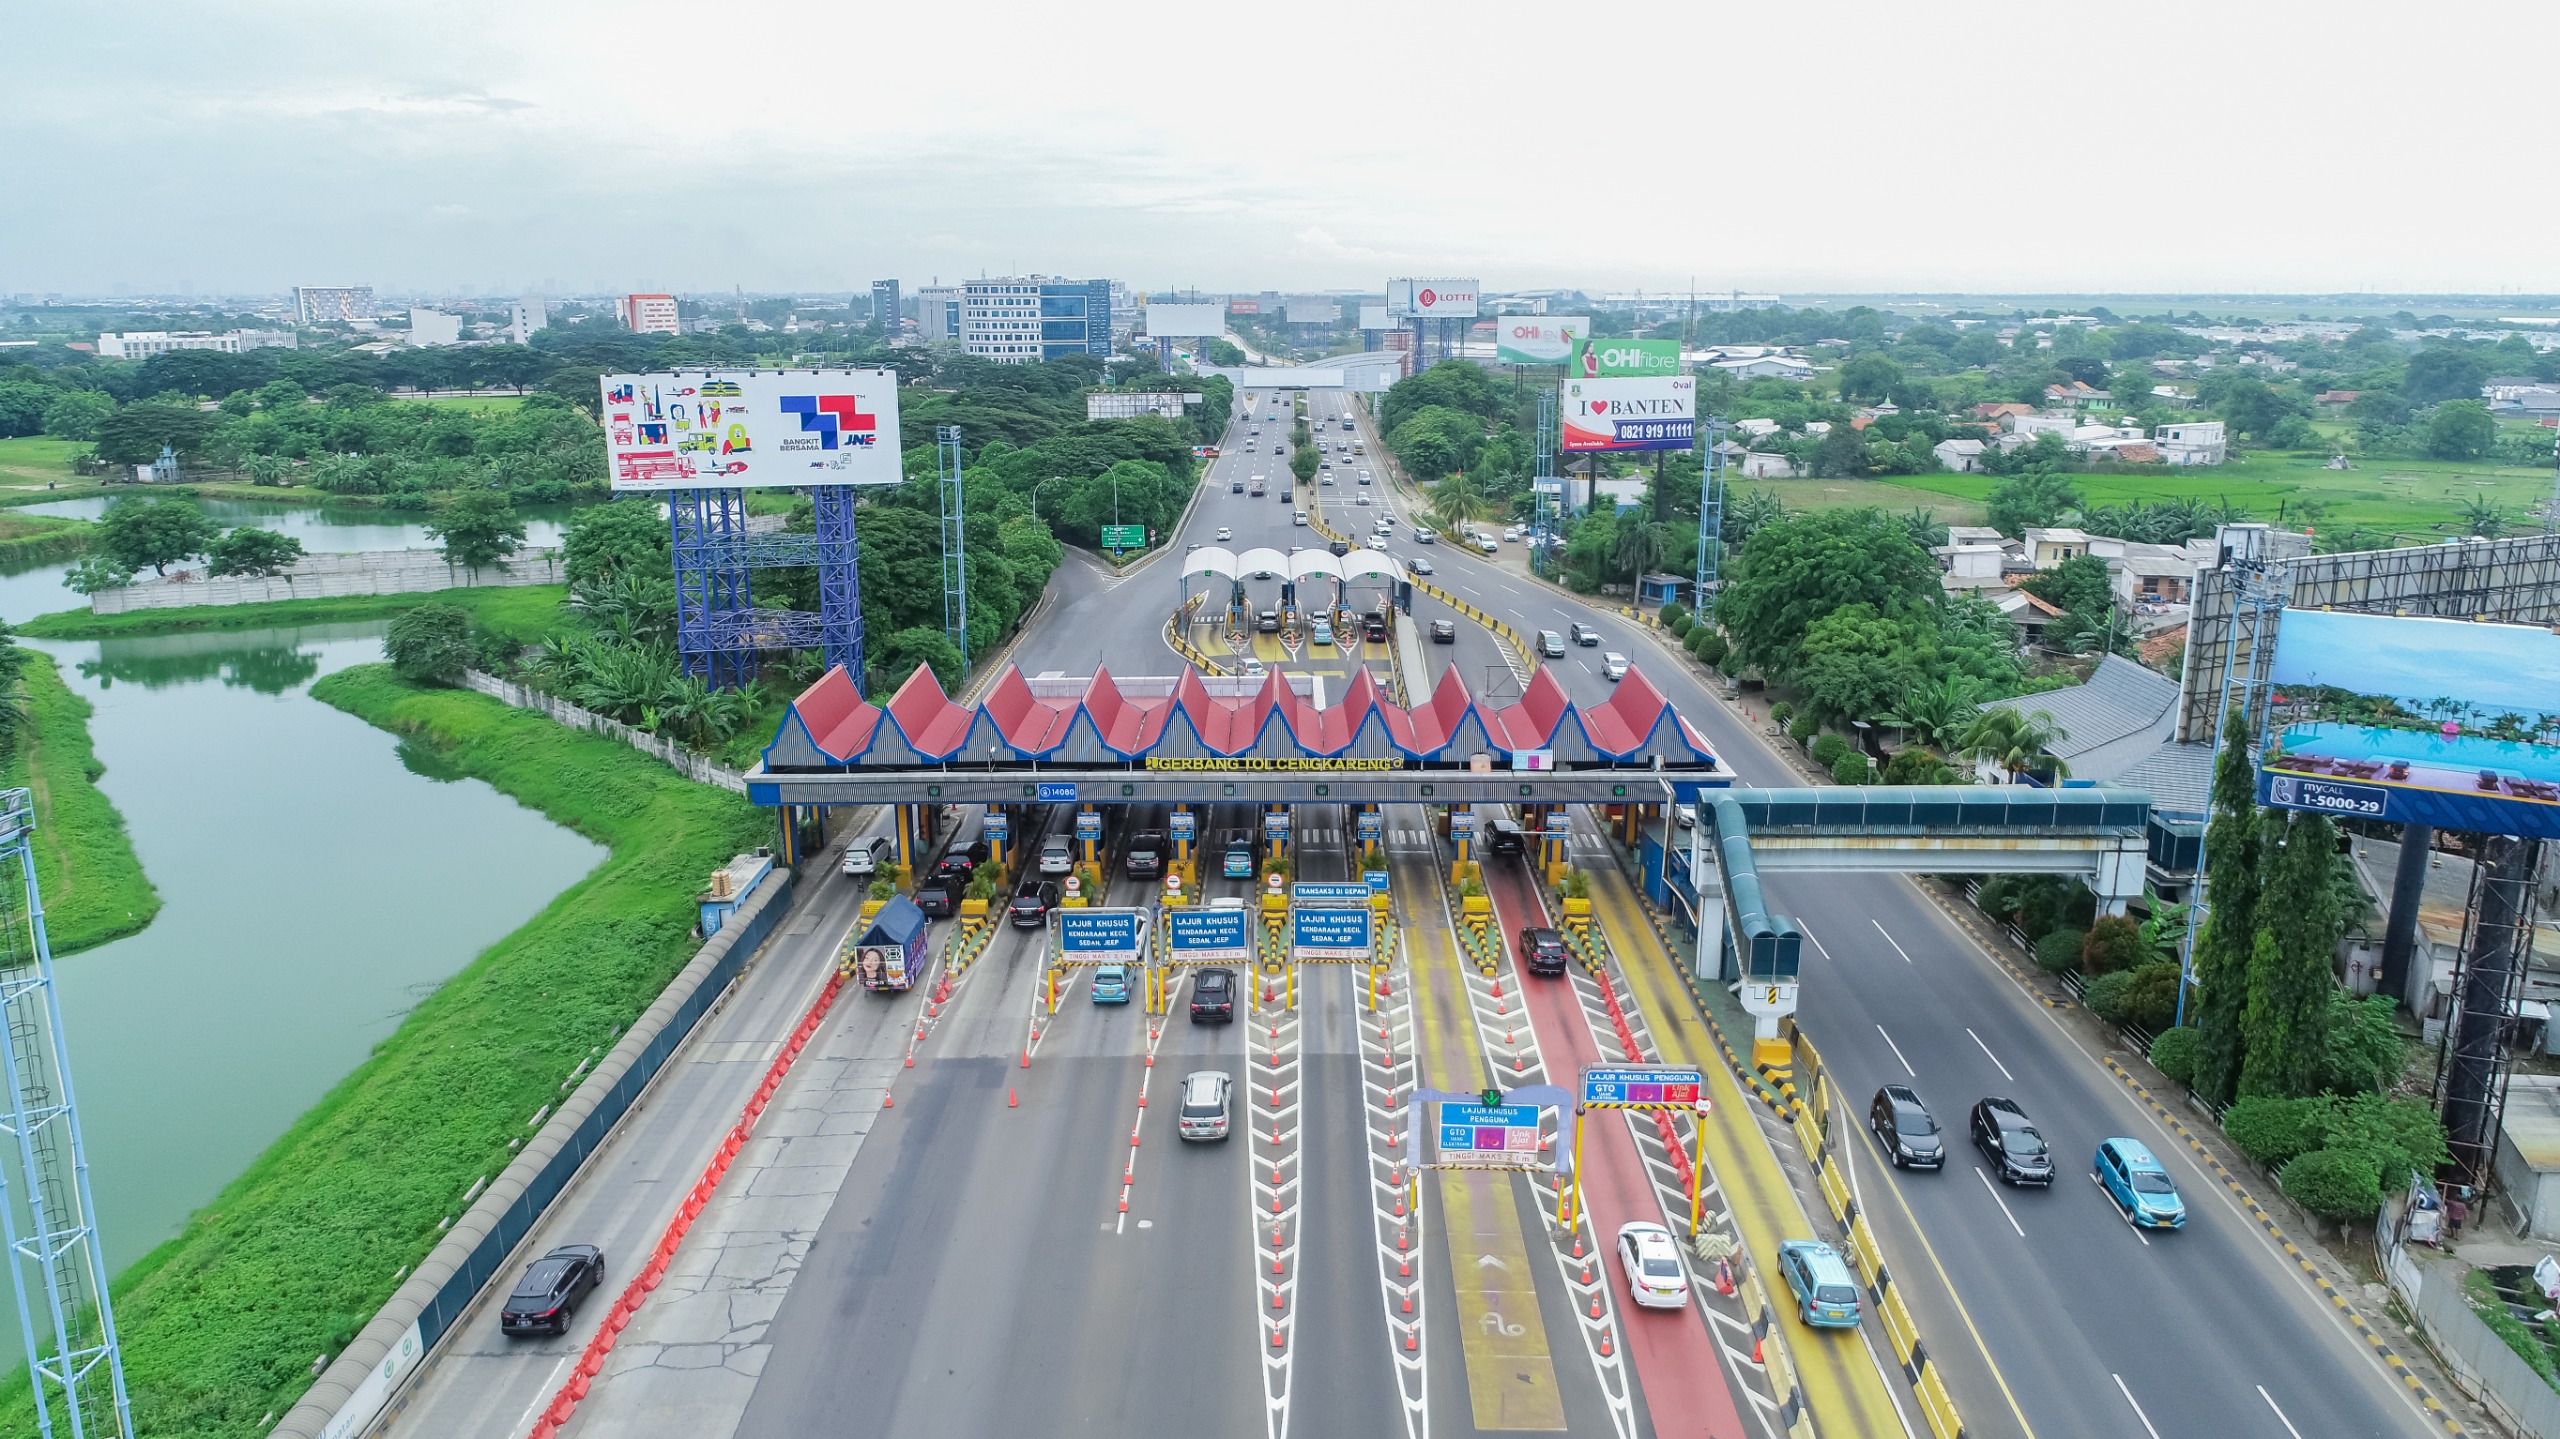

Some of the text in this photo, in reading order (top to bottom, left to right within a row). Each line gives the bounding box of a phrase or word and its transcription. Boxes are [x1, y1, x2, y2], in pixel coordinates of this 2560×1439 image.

[1672, 381, 1692, 389] Oval
[1579, 399, 1684, 416] I BANTEN
[1621, 423, 1692, 439] 0821 919 11111
[844, 434, 876, 446] JNE
[1159, 758, 1239, 770] GERBANG
[1245, 758, 1274, 770] TOL
[1276, 758, 1391, 770] CENGKARENG
[1051, 788, 1075, 796] 14080
[2304, 783, 2344, 795] myCALL
[2303, 794, 2379, 812] 1-5000-29
[1297, 887, 1335, 895] TRANSAKSI
[1335, 887, 1343, 895] DI
[1096, 919, 1129, 927] KHUSUS
[1176, 916, 1238, 925] LAJUR KHUSUS
[1300, 915, 1362, 923] LAJUR KHUSUS
[1595, 1084, 1616, 1092] GTO
[1488, 1107, 1518, 1115] KHUSUS
[1470, 1115, 1509, 1124] PENGGUNA
[1449, 1128, 1466, 1136] GTO
[1511, 1130, 1530, 1138] Link
